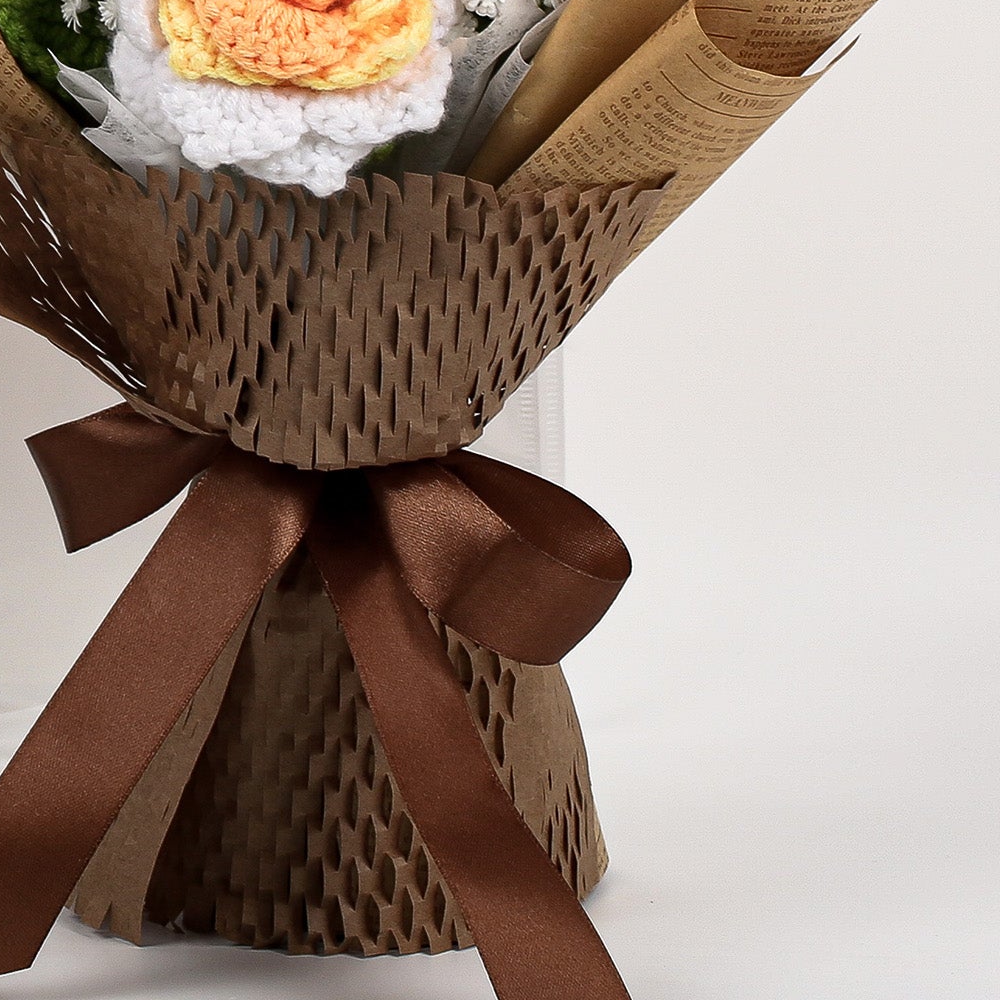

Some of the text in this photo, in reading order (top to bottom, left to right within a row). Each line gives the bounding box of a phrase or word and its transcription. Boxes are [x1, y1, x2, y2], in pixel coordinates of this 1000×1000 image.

[698, 43, 716, 59] did
[642, 80, 653, 91] to
[631, 87, 642, 99] to
[620, 96, 633, 109] do
[609, 104, 631, 126] calls.
[599, 111, 615, 128] out
[614, 129, 634, 146] that
[603, 135, 615, 148] So
